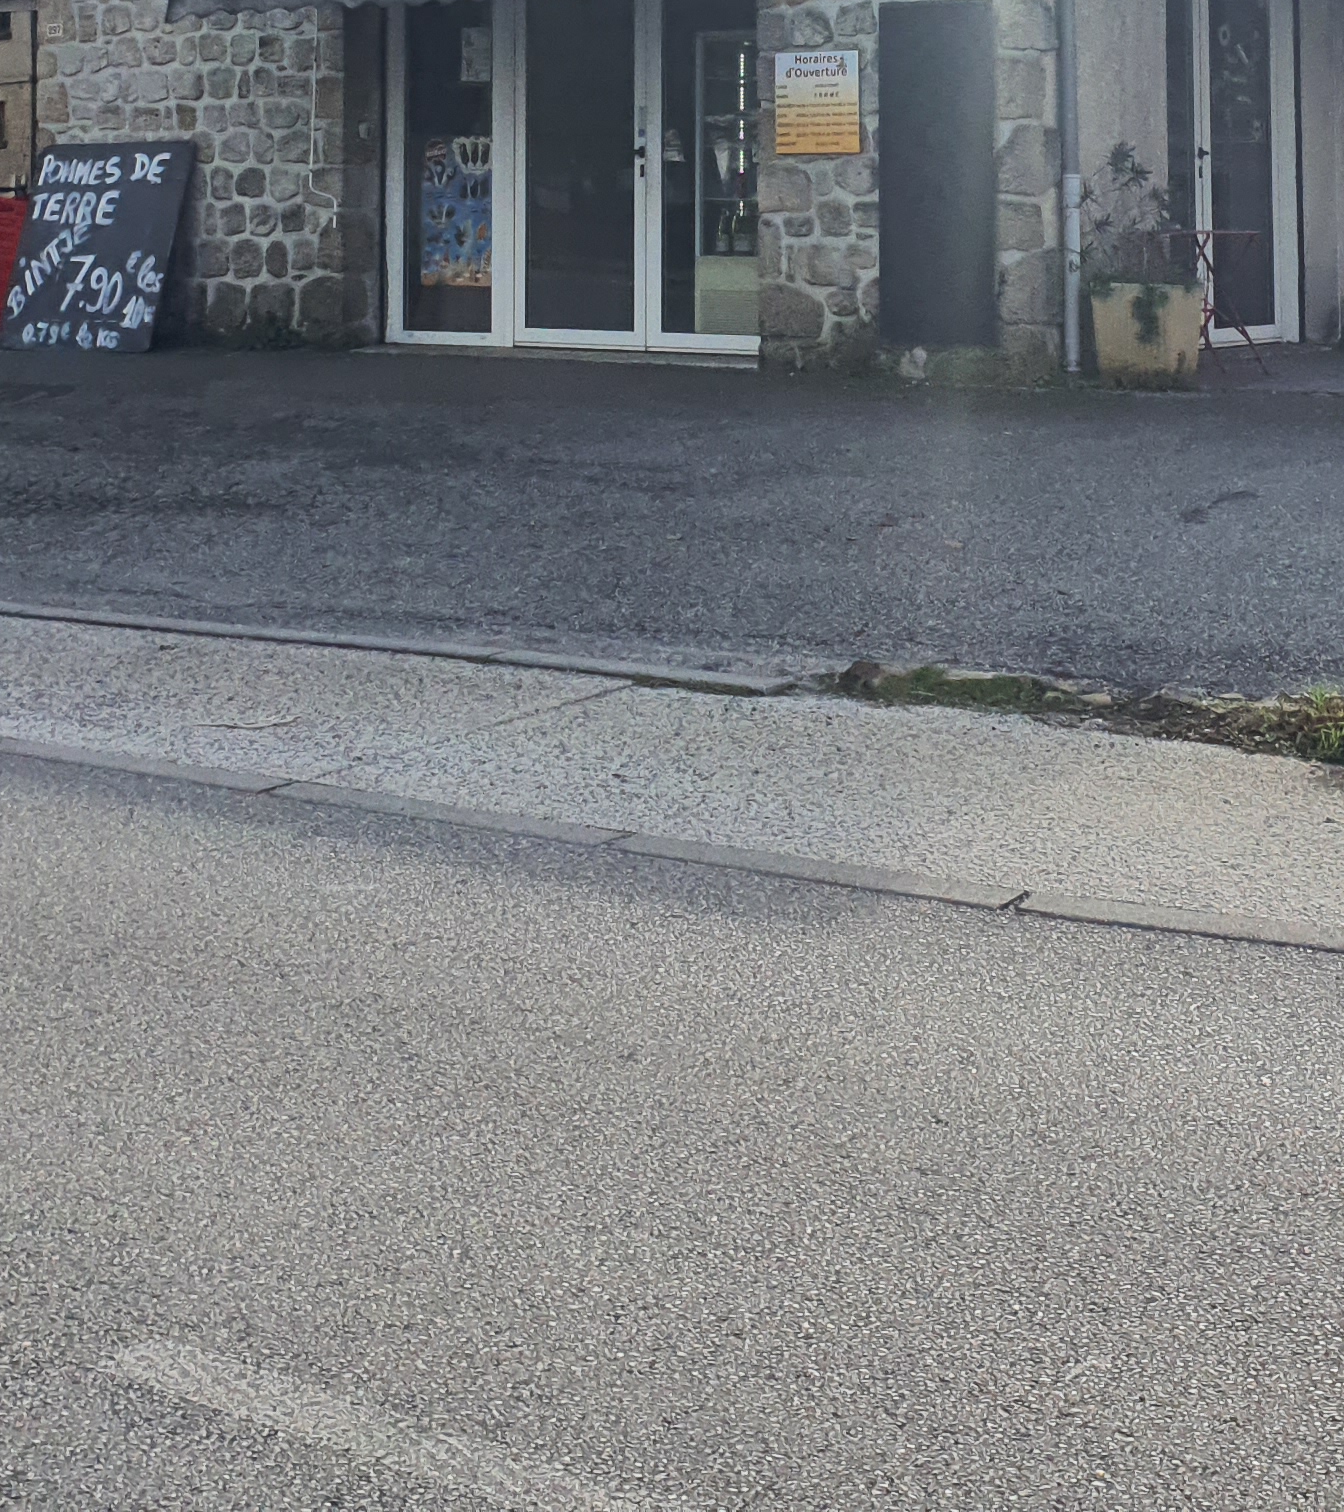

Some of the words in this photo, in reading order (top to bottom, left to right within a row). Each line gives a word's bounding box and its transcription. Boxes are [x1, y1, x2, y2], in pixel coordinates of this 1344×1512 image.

[795, 54, 838, 65] Horaires
[38, 153, 122, 186] POMMES
[130, 152, 172, 184] DE
[32, 190, 121, 226] TERRE
